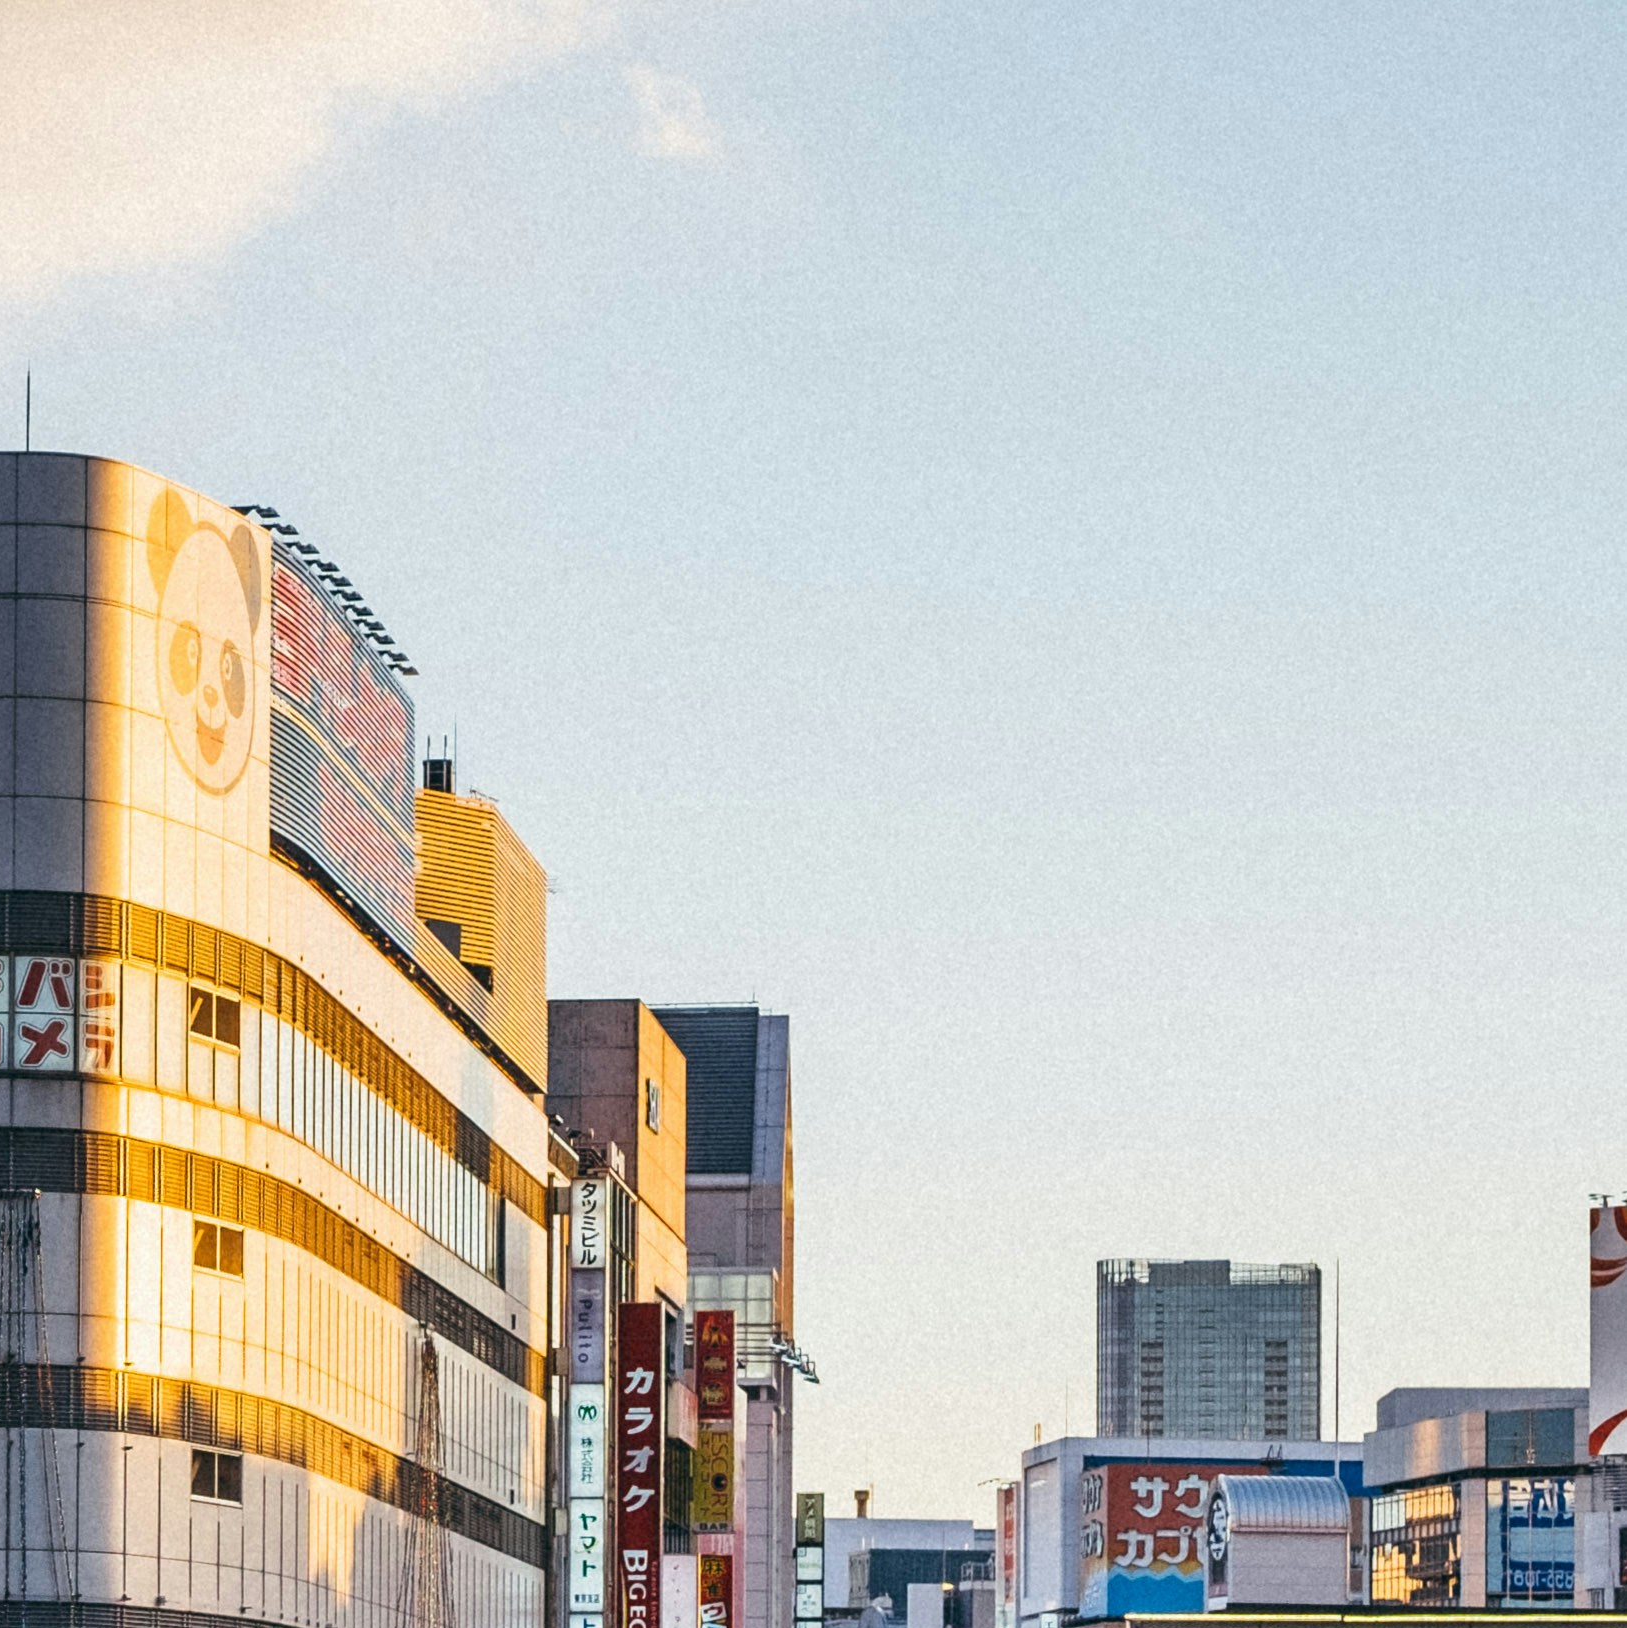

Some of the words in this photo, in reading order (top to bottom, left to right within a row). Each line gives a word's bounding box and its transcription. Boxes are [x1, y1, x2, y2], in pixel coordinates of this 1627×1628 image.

[580, 1181, 599, 1266] タツミビル
[622, 1366, 655, 1513] カラオケ
[579, 1513, 598, 1577] ヤマト
[699, 1522, 729, 1532] BAR
[622, 1550, 648, 1600] BIG
[702, 1558, 727, 1599] 麻雀
